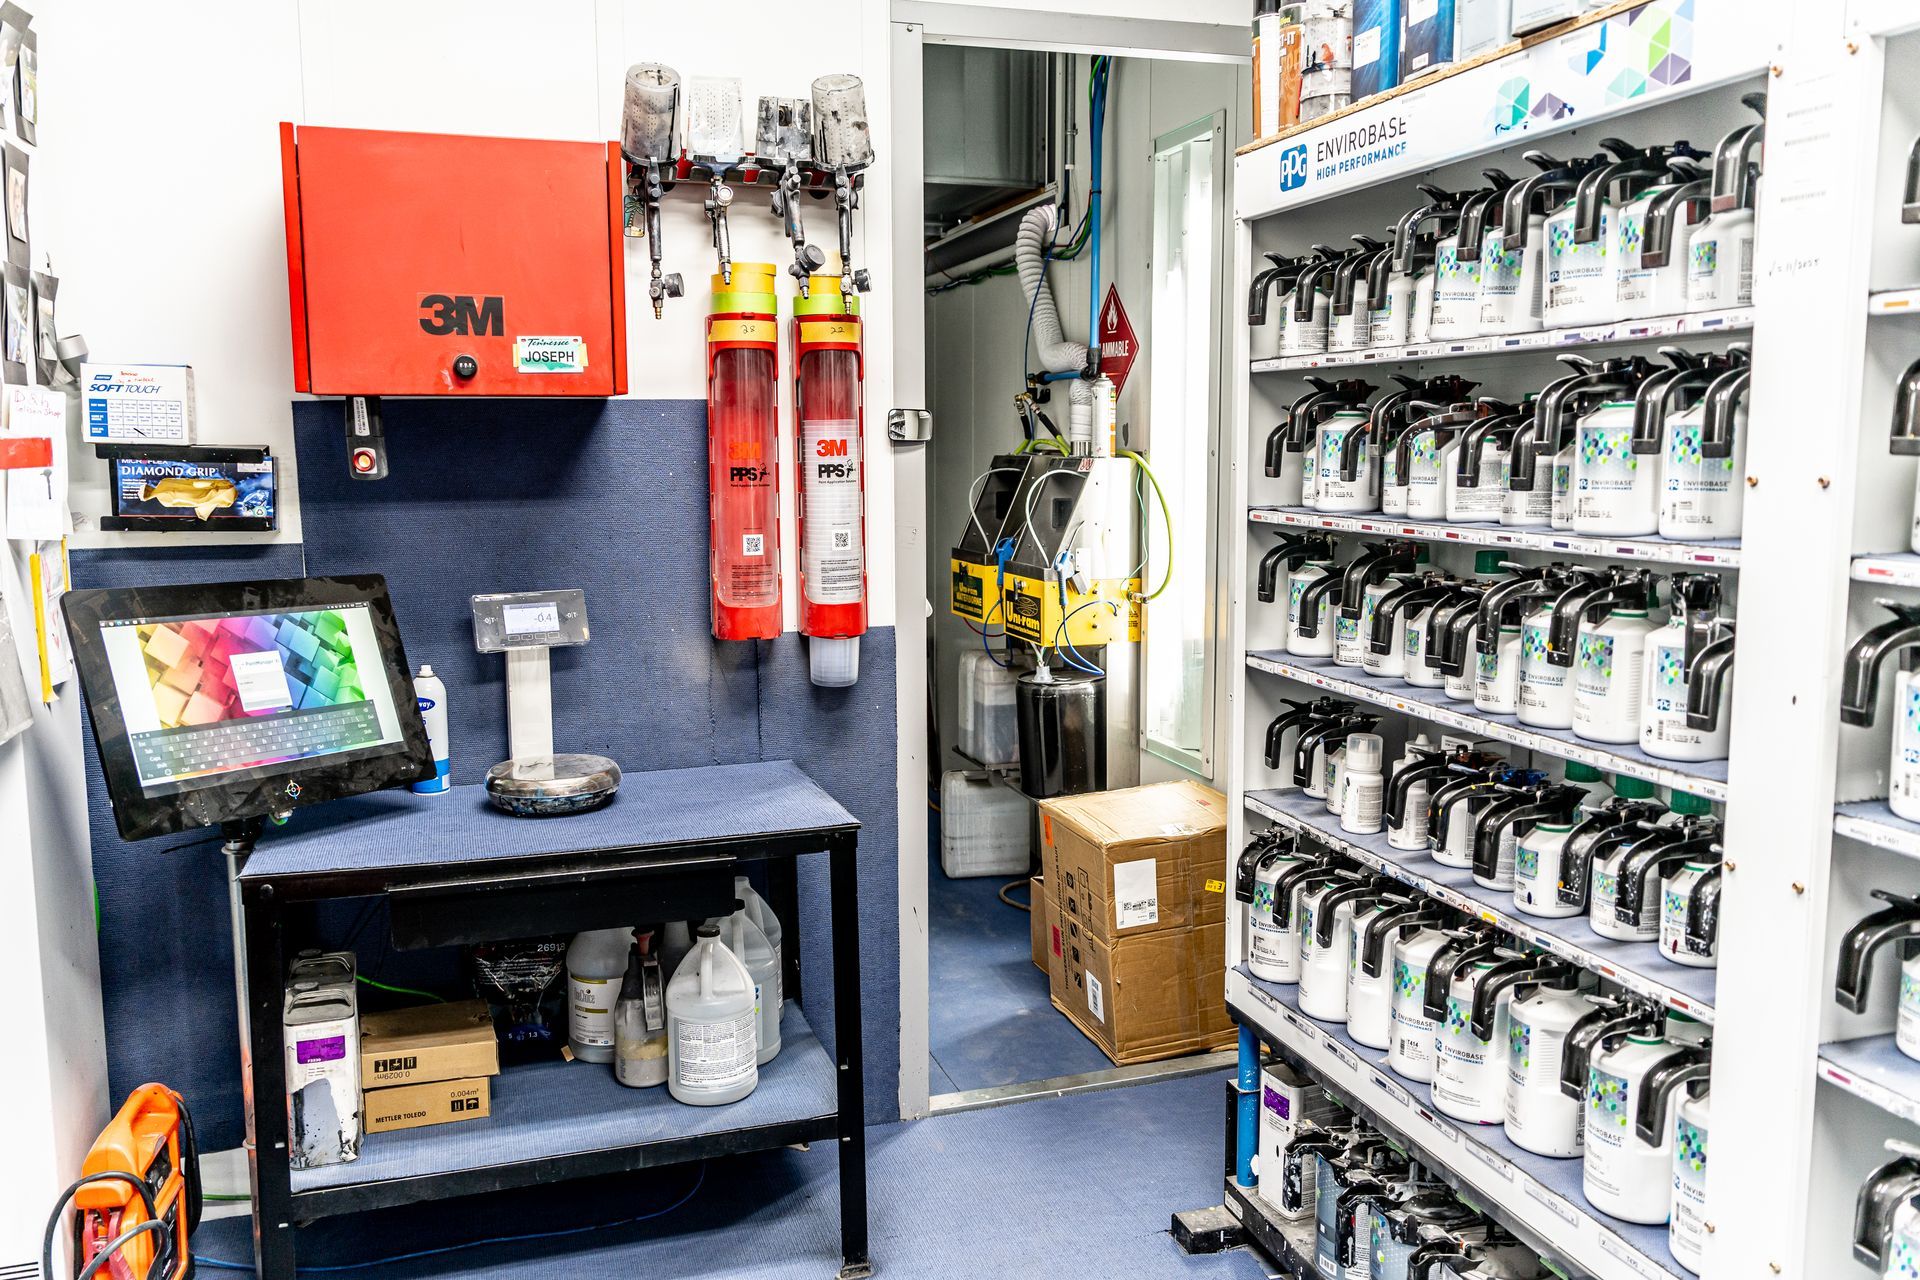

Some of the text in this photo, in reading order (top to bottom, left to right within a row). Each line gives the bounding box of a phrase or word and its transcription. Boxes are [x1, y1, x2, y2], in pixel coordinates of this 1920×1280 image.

[1316, 117, 1407, 162] ENVIROBASE
[1280, 147, 1307, 189] PPG
[1316, 141, 1407, 181] HIGH PERFORMANCE
[419, 294, 504, 336] 3M
[527, 338, 570, 347] Tennessee
[1099, 340, 1129, 358] AMMABLE
[525, 351, 575, 363] JOSEPH
[89, 384, 160, 394] SOFT TOUCH
[729, 441, 761, 460] 3M
[817, 439, 847, 457] 3M
[121, 466, 216, 477] DIAMOND GRIP
[730, 467, 758, 481] PPS
[818, 464, 845, 478] PPS
[1683, 480, 1729, 488] ENVIROBASE
[1006, 601, 1040, 631] Uni-ram
[1259, 921, 1290, 931] ENVIROB
[1398, 1012, 1434, 1028] ENVIROBASE
[1445, 1045, 1484, 1060] ENVIROBASE
[375, 1111, 427, 1123] METTLER TOLEDO
